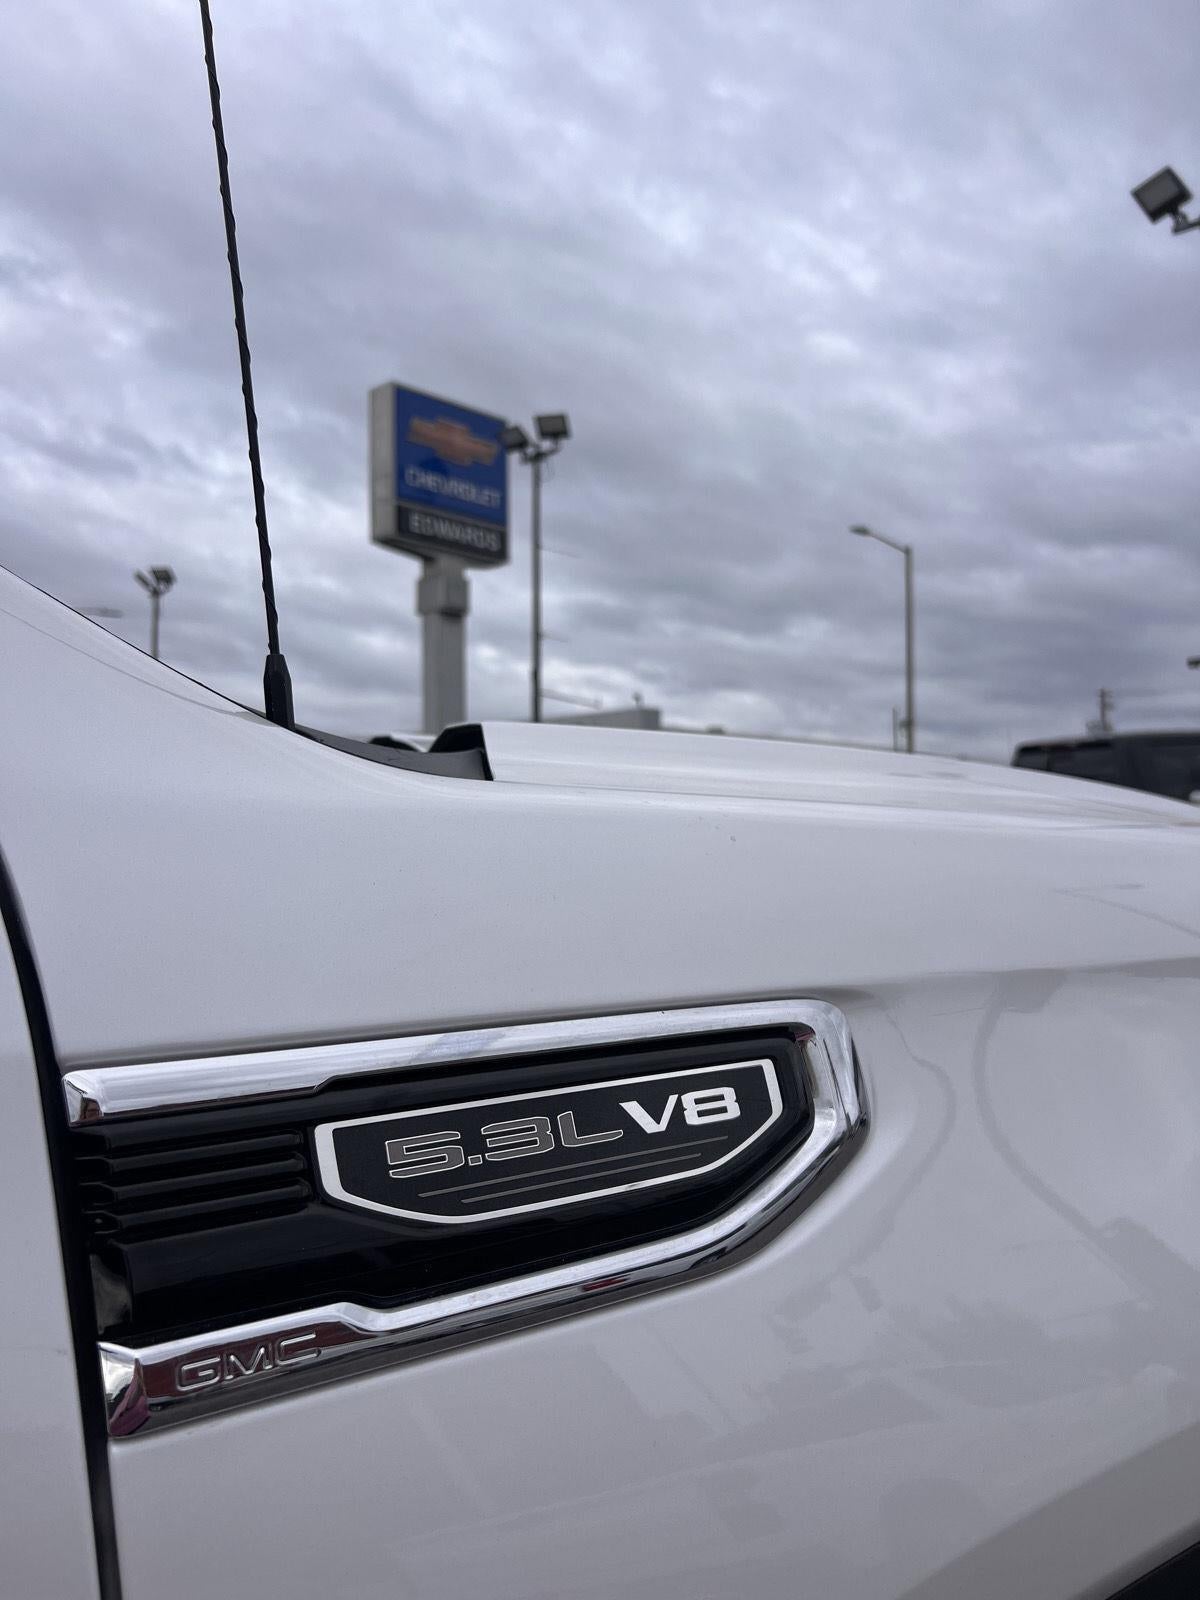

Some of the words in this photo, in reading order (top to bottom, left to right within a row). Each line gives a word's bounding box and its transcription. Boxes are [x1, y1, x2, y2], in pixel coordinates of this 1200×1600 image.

[404, 465, 500, 507] CHEVROLET
[409, 513, 499, 550] EDWARDS
[385, 1111, 624, 1178] 5.3L
[619, 1086, 741, 1134] V8
[176, 1331, 322, 1392] GMC
